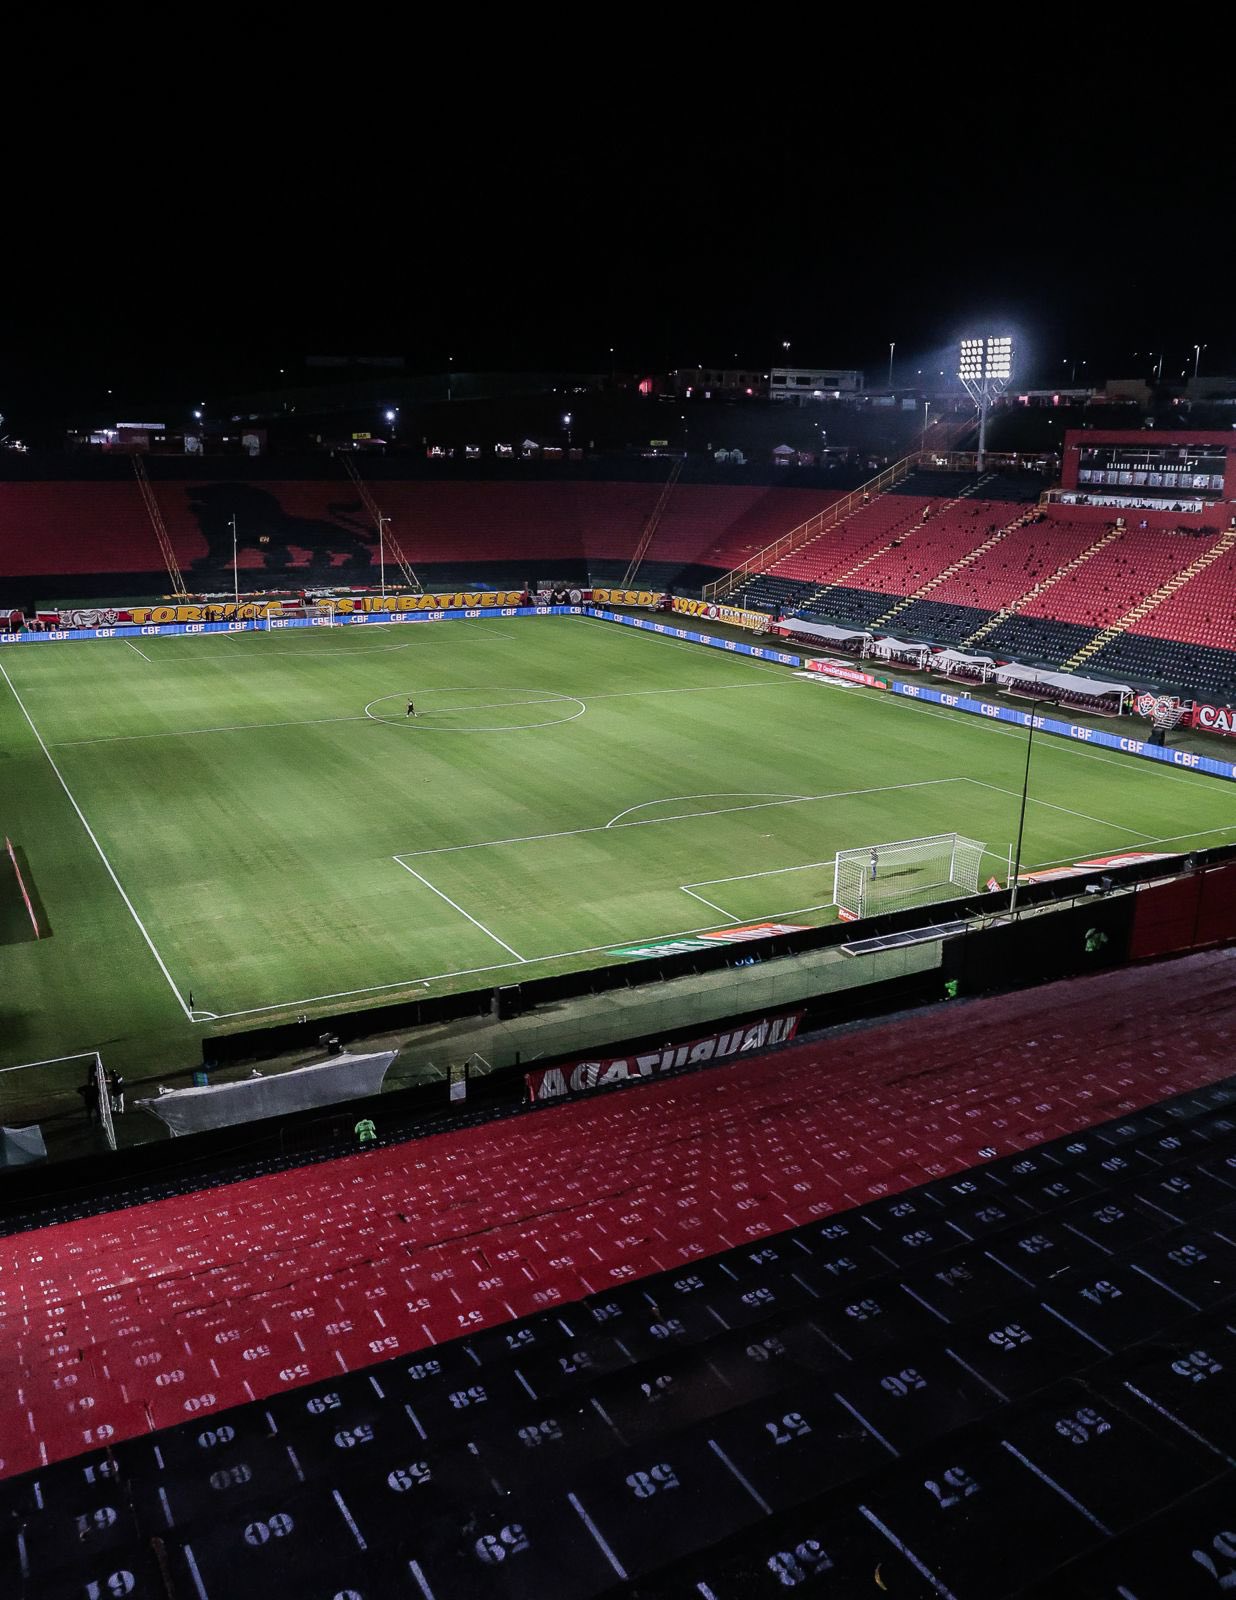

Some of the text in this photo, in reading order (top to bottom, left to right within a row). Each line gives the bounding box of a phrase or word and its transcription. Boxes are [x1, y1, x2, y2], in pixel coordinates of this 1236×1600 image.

[465, 610, 481, 618] CBF
[501, 608, 517, 616] CBF
[594, 610, 604, 618] CBF
[673, 597, 708, 617] 1997
[229, 622, 248, 630] CBF
[271, 620, 289, 628] CBF
[614, 614, 623, 622] CBF
[634, 618, 644, 628] CBF
[49, 632, 69, 640] CBF
[96, 629, 116, 637] CBF
[141, 626, 160, 635] CBF
[186, 624, 205, 632] CBF
[654, 624, 665, 633] CBF
[676, 629, 688, 638] CBF
[1, 634, 22, 642] CBF
[700, 634, 712, 644] CBF
[725, 640, 736, 650] CBF
[751, 647, 763, 657] CBF
[778, 653, 792, 663] CBF
[903, 684, 920, 696] CBF
[940, 694, 958, 706] CBF
[981, 704, 1000, 717] CBF
[1024, 714, 1045, 728] CBF
[1071, 726, 1092, 740] CBF
[1120, 738, 1144, 752] CBF
[1174, 752, 1200, 768] CBF
[951, 1181, 977, 1195] 51
[1042, 1182, 1070, 1197] 51
[1160, 1177, 1191, 1193] 51
[821, 1224, 849, 1239] 53
[902, 1230, 933, 1247] 53
[549, 1256, 574, 1269] 55
[748, 1249, 779, 1265] 54
[609, 1264, 636, 1279] 55
[823, 1257, 857, 1274] 54
[477, 1277, 504, 1291] 56
[673, 1276, 705, 1293] 55
[533, 1287, 562, 1303] 56
[741, 1287, 775, 1306] 55
[1079, 1280, 1123, 1305] 54
[406, 1298, 431, 1313] 57
[592, 1303, 623, 1322] 56
[845, 1299, 881, 1320] 55
[457, 1310, 484, 1327] 57
[325, 1320, 353, 1335] 58
[649, 1319, 685, 1338] 56
[368, 1336, 399, 1353] 58
[505, 1329, 535, 1349] 57
[988, 1324, 1033, 1350] 55
[242, 1345, 271, 1361] 59
[407, 1360, 441, 1380] 58
[558, 1351, 592, 1373] 57
[1171, 1350, 1223, 1383] 55
[155, 1369, 185, 1386] 60
[279, 1364, 310, 1381] 59
[880, 1368, 927, 1397] 56
[183, 1393, 217, 1412] 60
[306, 1392, 342, 1414] 59
[448, 1386, 488, 1409] 58
[517, 1419, 563, 1445] 58
[765, 1412, 812, 1445] 57
[1055, 1407, 1112, 1444] 56
[82, 1424, 114, 1444] 61
[198, 1425, 235, 1448] 60
[334, 1425, 374, 1448] 59
[83, 1460, 119, 1483] 61
[387, 1462, 431, 1492] 59
[625, 1463, 680, 1498] 58
[924, 1466, 978, 1509] 57
[76, 1506, 117, 1530] 61
[244, 1512, 294, 1545] 60
[475, 1524, 528, 1561] 59
[767, 1539, 833, 1586] 58
[86, 1570, 135, 1599] 61
